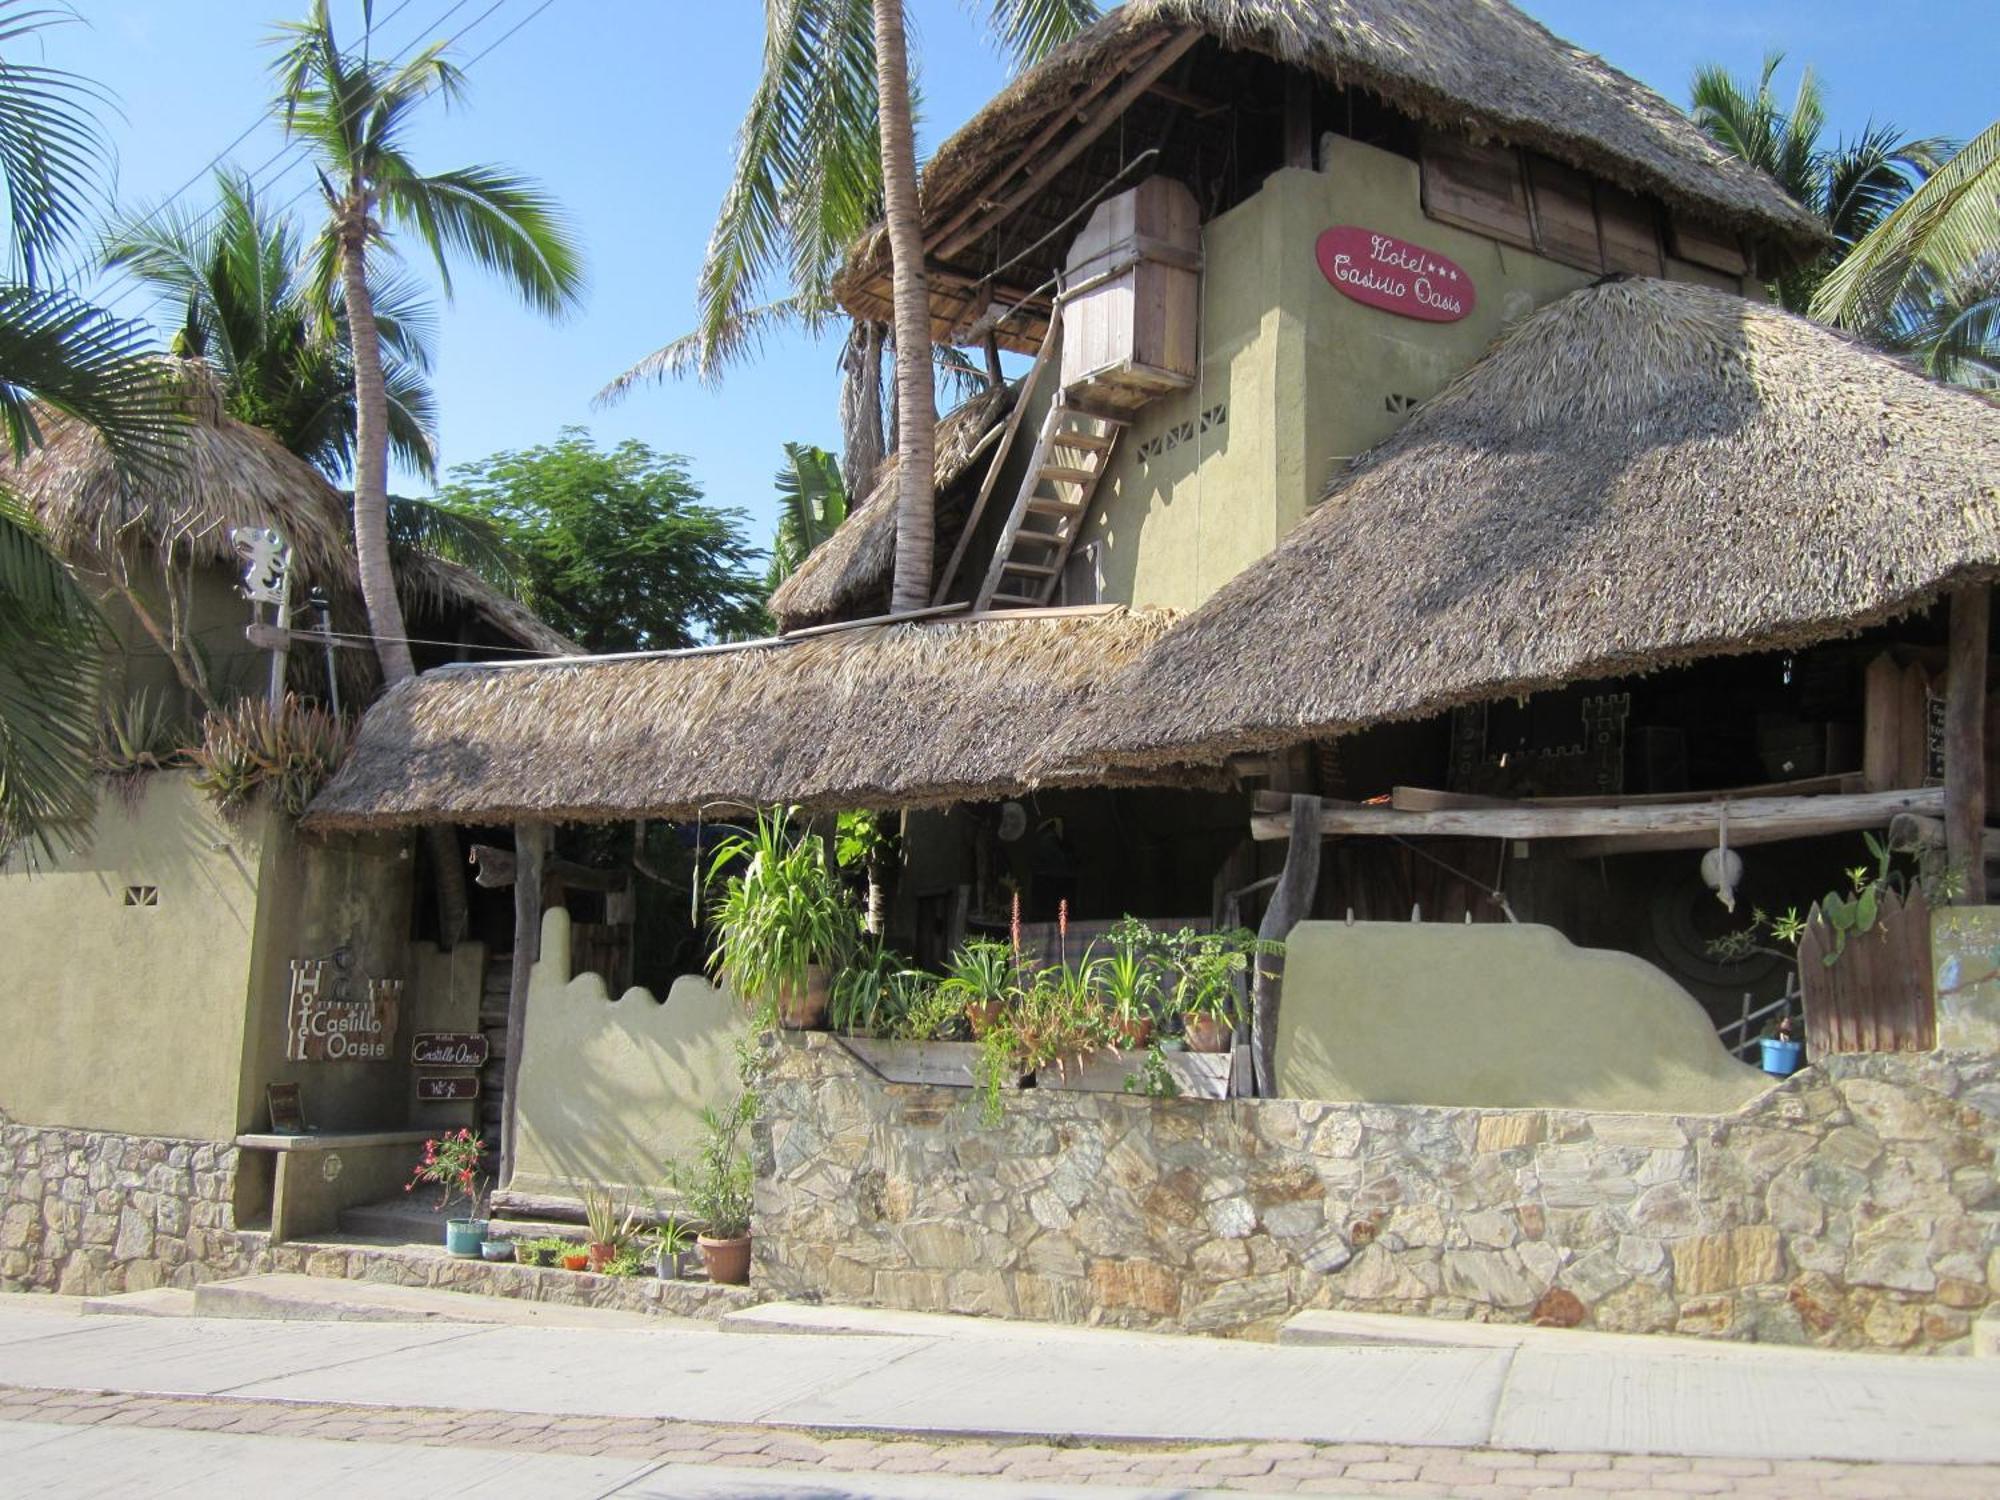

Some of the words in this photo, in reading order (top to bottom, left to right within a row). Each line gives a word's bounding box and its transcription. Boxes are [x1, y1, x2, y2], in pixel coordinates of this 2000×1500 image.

[1370, 235, 1426, 274] Hotel
[1334, 254, 1407, 297] Castillo
[1415, 276, 1461, 313] Oasis
[311, 1010, 382, 1036] Castillo
[327, 1033, 385, 1058] Oasis
